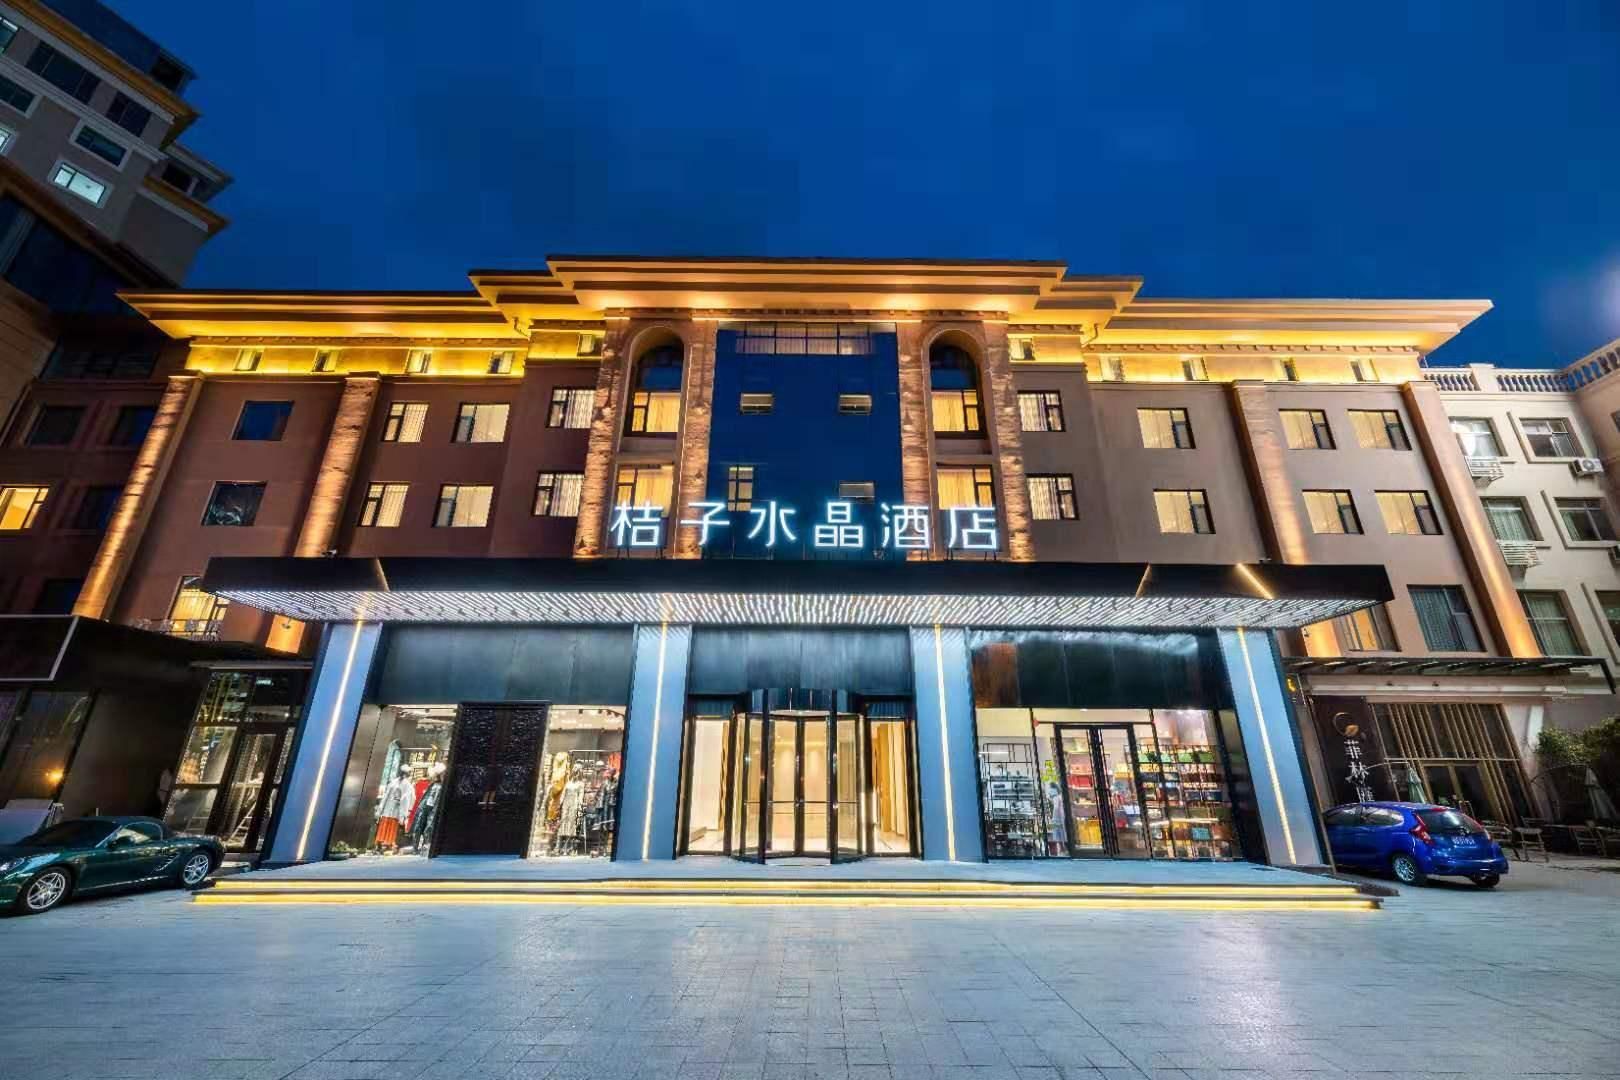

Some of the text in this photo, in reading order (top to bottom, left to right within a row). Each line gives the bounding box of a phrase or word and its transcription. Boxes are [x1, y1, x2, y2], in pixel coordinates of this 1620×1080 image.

[611, 501, 998, 549] 桔子水晶酒店
